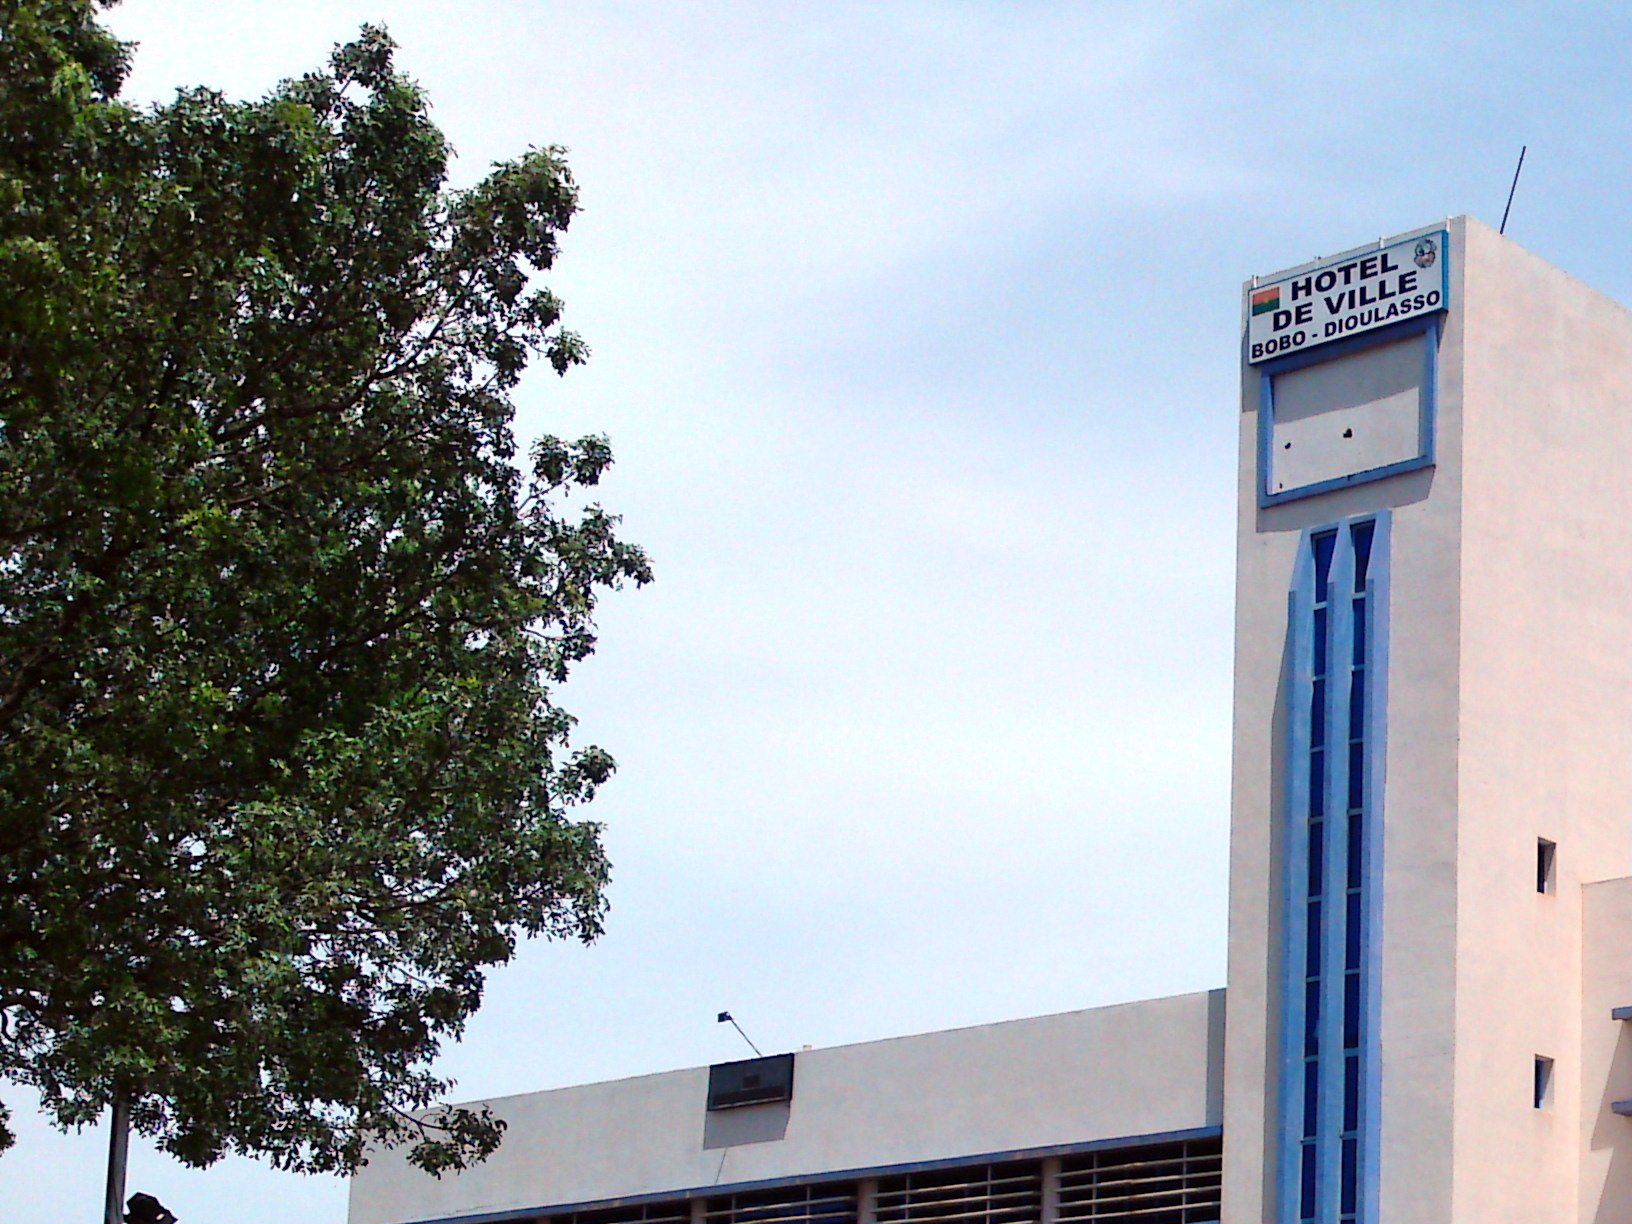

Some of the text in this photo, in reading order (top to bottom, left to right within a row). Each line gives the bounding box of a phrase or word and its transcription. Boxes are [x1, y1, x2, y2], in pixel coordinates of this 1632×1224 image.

[1272, 270, 1418, 332] DE VILLE
[1291, 252, 1399, 302] HOTEL
[1251, 330, 1306, 359] BOBO
[1324, 290, 1440, 337] DIOULASSO
